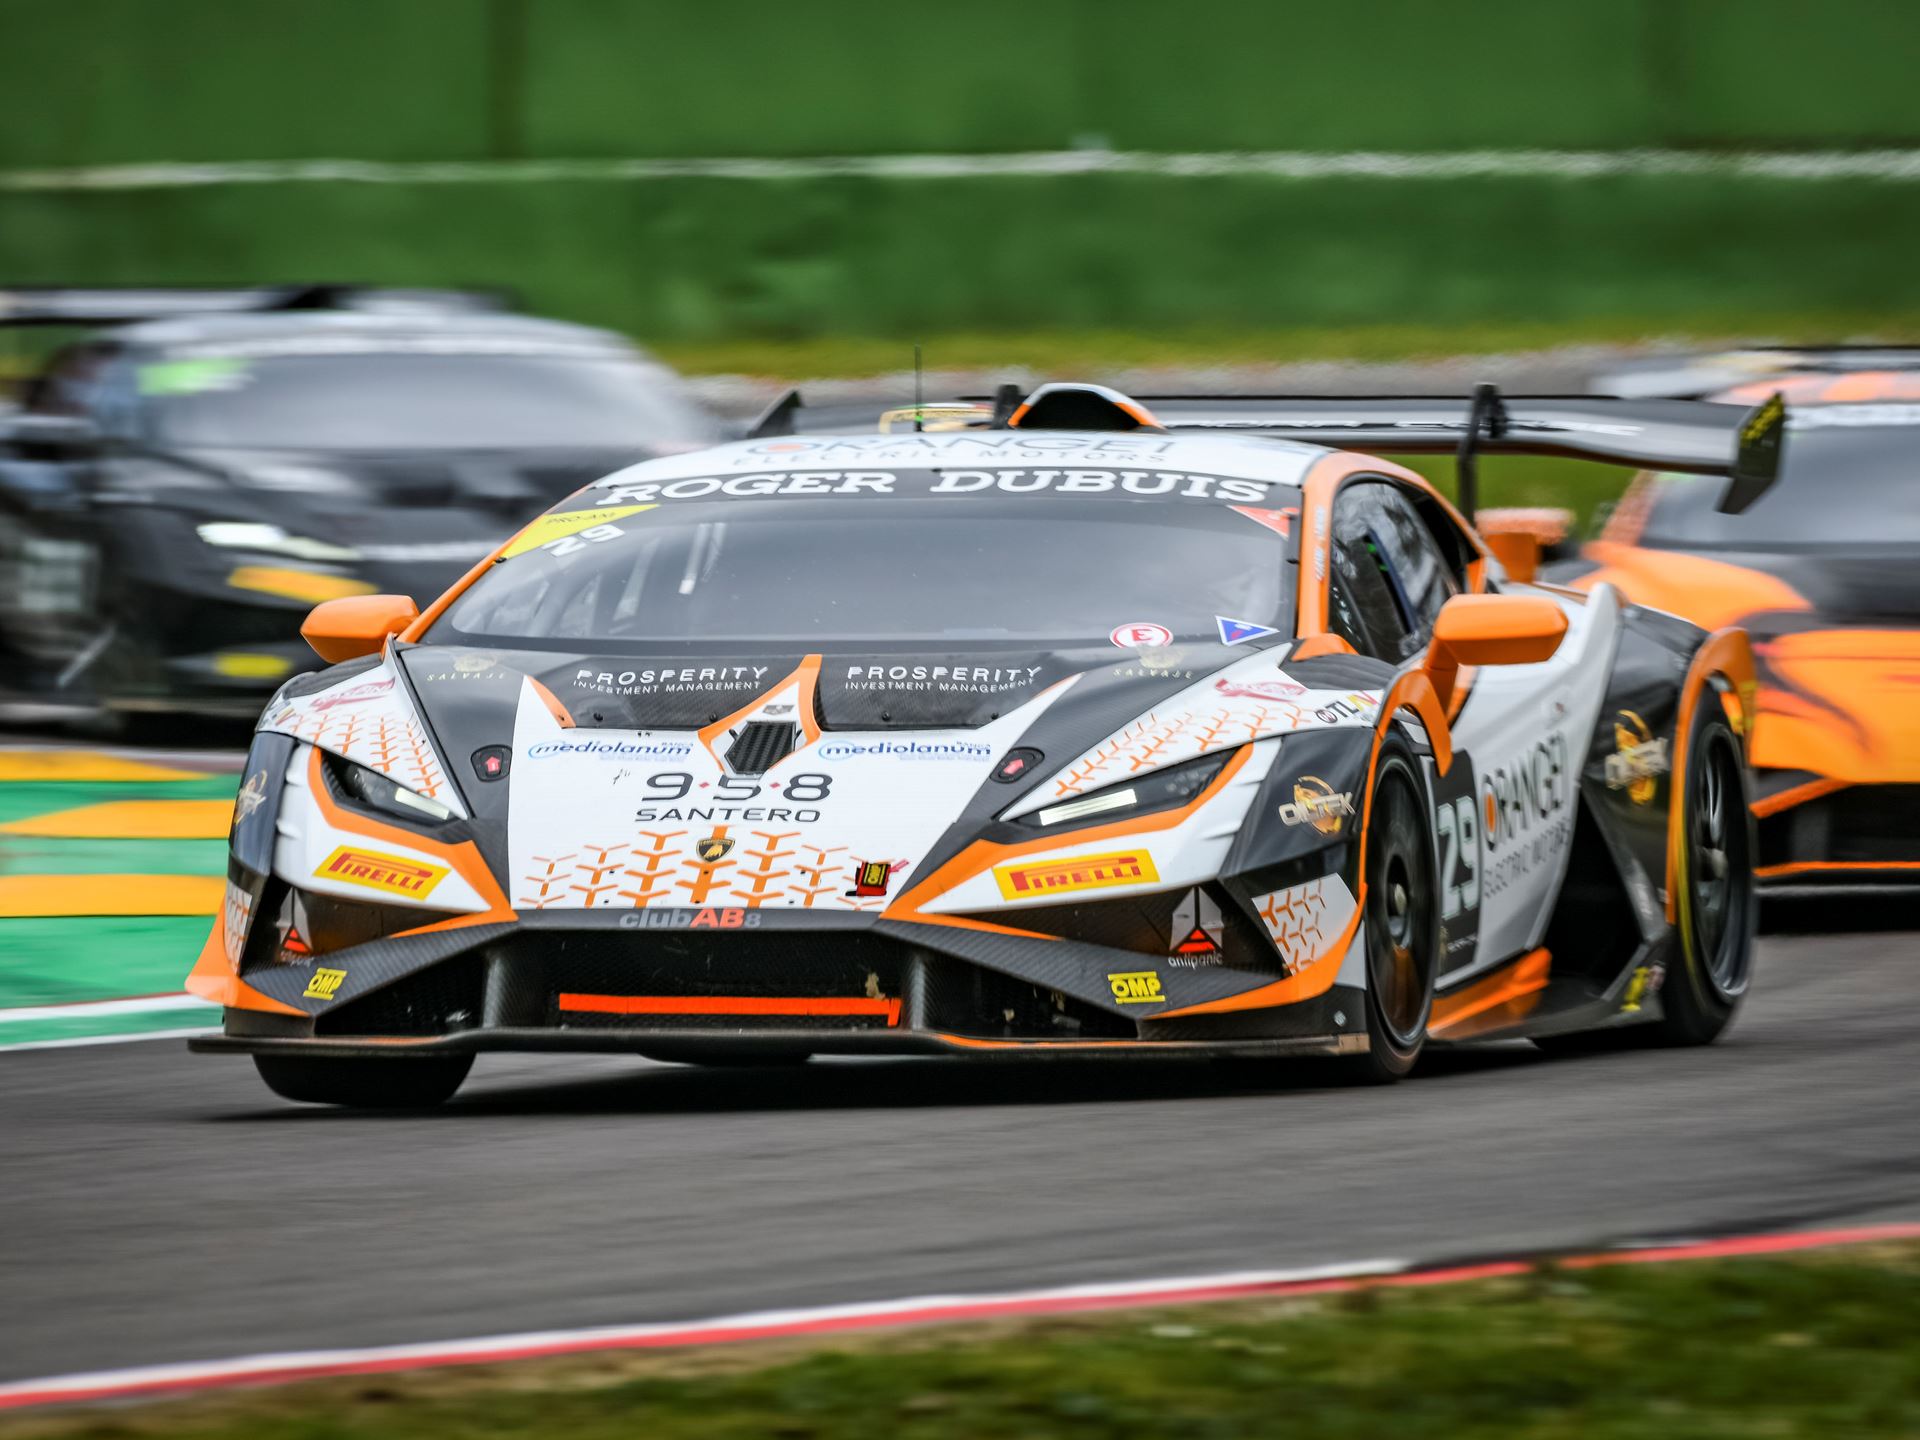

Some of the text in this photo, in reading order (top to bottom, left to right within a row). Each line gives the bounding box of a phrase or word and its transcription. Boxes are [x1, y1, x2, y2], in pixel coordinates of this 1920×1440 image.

[596, 470, 1268, 505] ROGER DUBUIS
[541, 524, 626, 557] 29
[576, 666, 768, 686] PROSPERITY
[847, 666, 1042, 681] PROSPERITY
[573, 679, 761, 695] INVESTMENT MANAGEMENT
[844, 678, 1034, 693] INVESTMENT MANAGEMENT
[535, 740, 691, 757] mediolanum
[826, 741, 991, 757] mediolanum
[635, 807, 820, 823] SANTERO
[327, 851, 434, 891] PIRELLI
[1009, 856, 1141, 892] PIRELLI
[1168, 950, 1224, 970] antipanic
[308, 974, 343, 994] OMP
[1111, 976, 1161, 998] OMP
